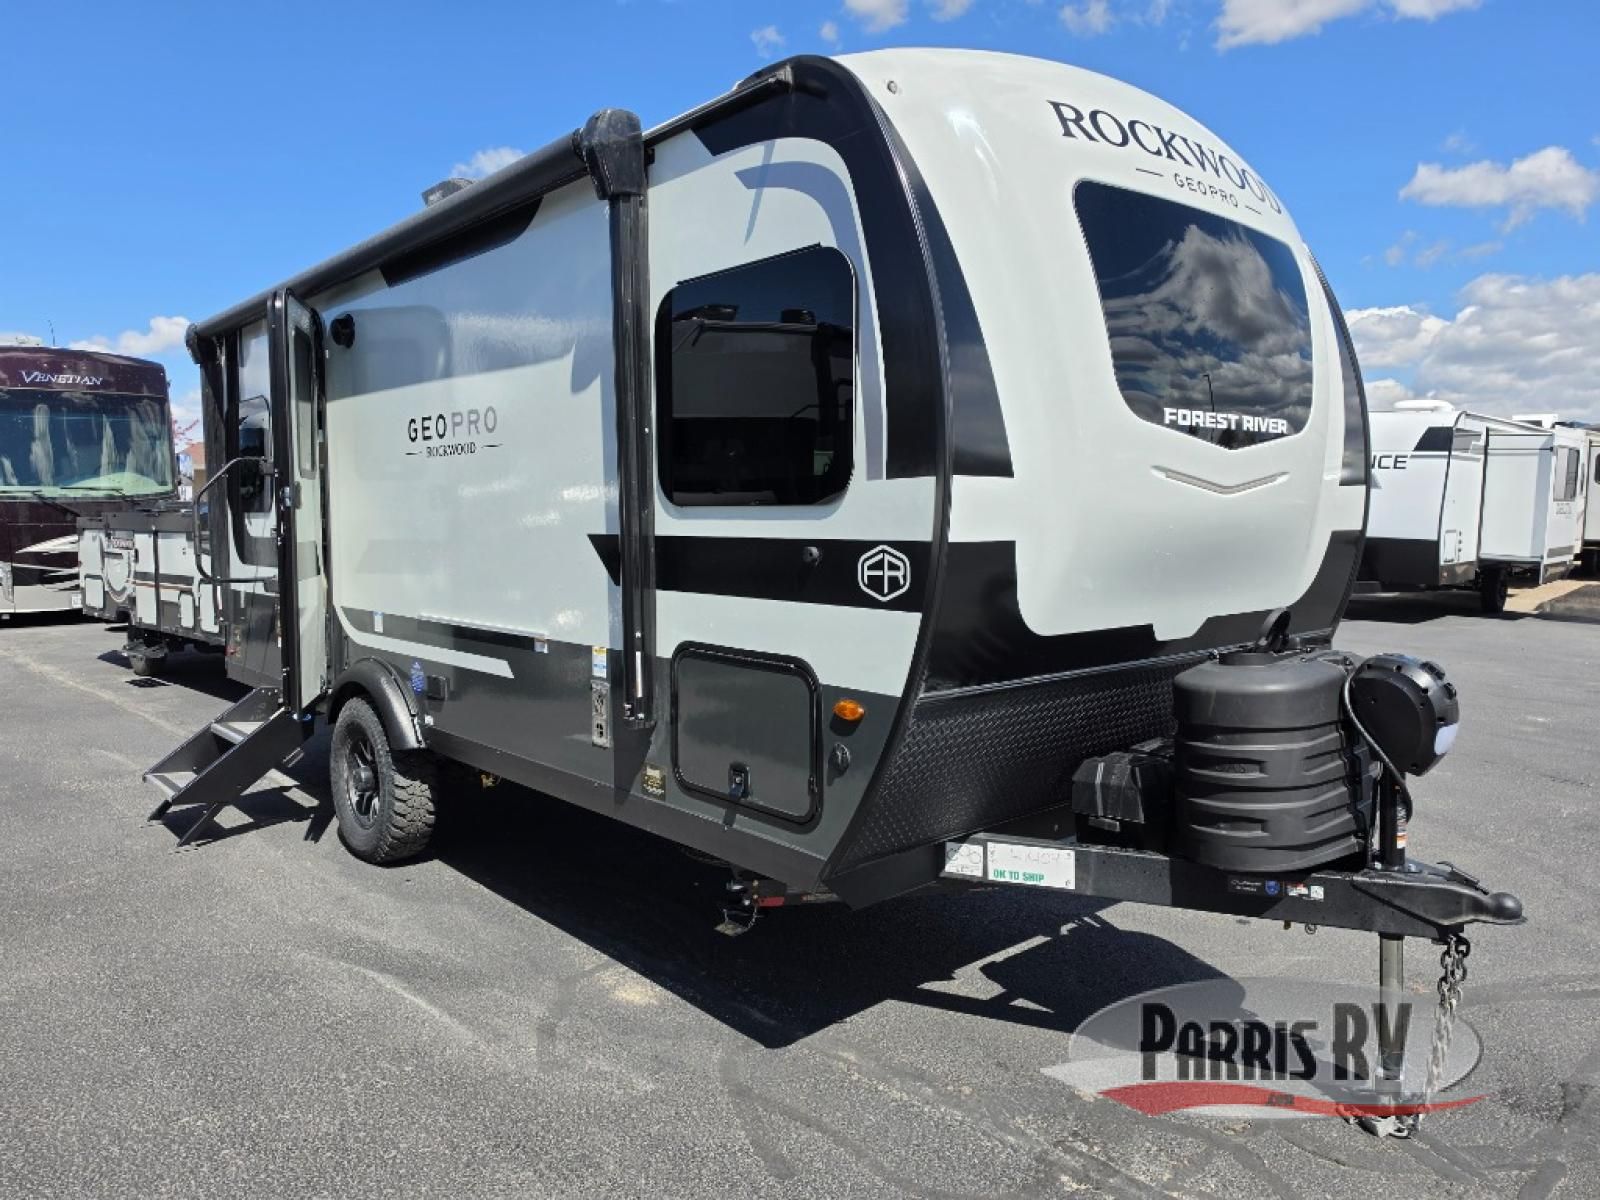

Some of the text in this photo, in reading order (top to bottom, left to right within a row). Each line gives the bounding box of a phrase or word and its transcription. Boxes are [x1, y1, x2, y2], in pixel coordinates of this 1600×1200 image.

[1047, 100, 1282, 214] ROCKWOOD
[1174, 172, 1239, 208] GEOPRO
[20, 370, 103, 385] VENETIAN
[407, 405, 498, 442] GEOPRO
[1163, 407, 1288, 434] FOREST RIVER
[426, 442, 478, 458] ROCKWOOD
[993, 868, 1045, 883] OK TO SHIP
